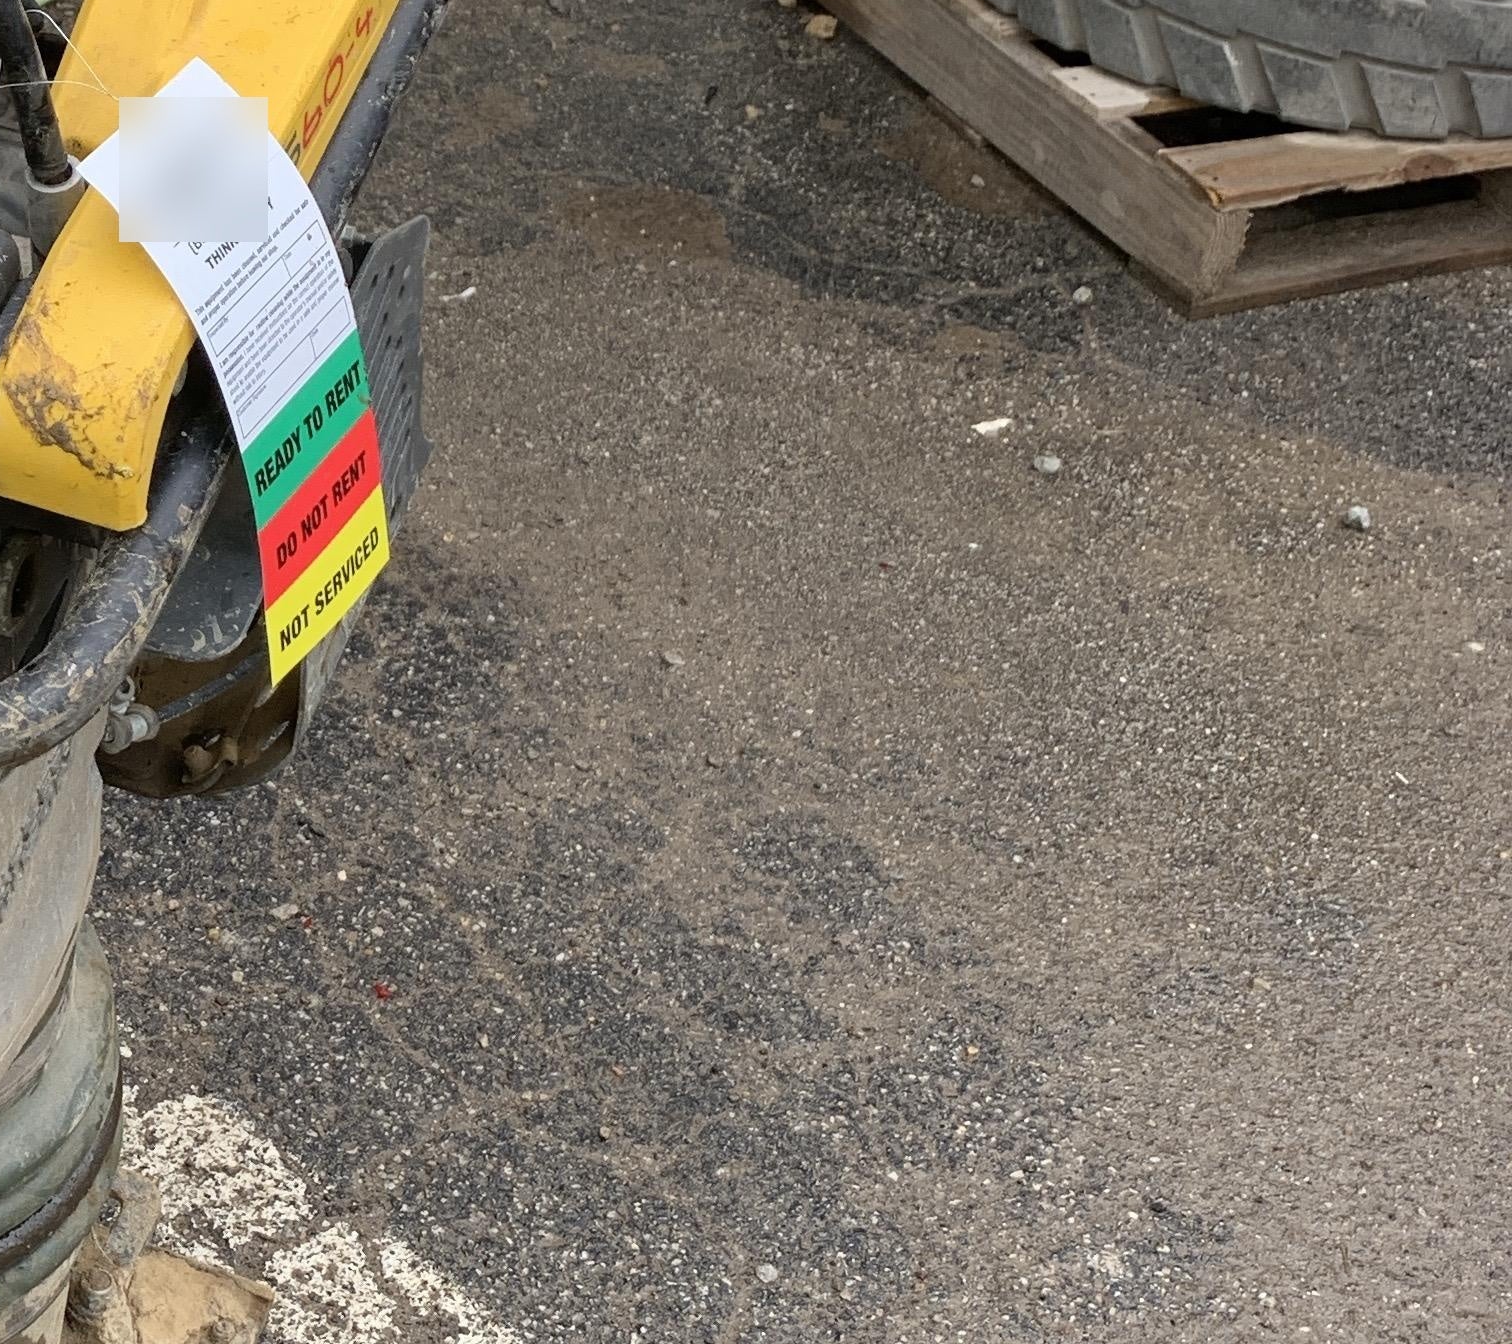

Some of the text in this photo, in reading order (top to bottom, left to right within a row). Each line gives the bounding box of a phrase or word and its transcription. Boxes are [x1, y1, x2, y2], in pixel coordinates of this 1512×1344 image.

[254, 360, 363, 498] READY TO RENT
[276, 450, 367, 570] DO NOT RENT
[280, 525, 380, 652] NOT SERVICED
